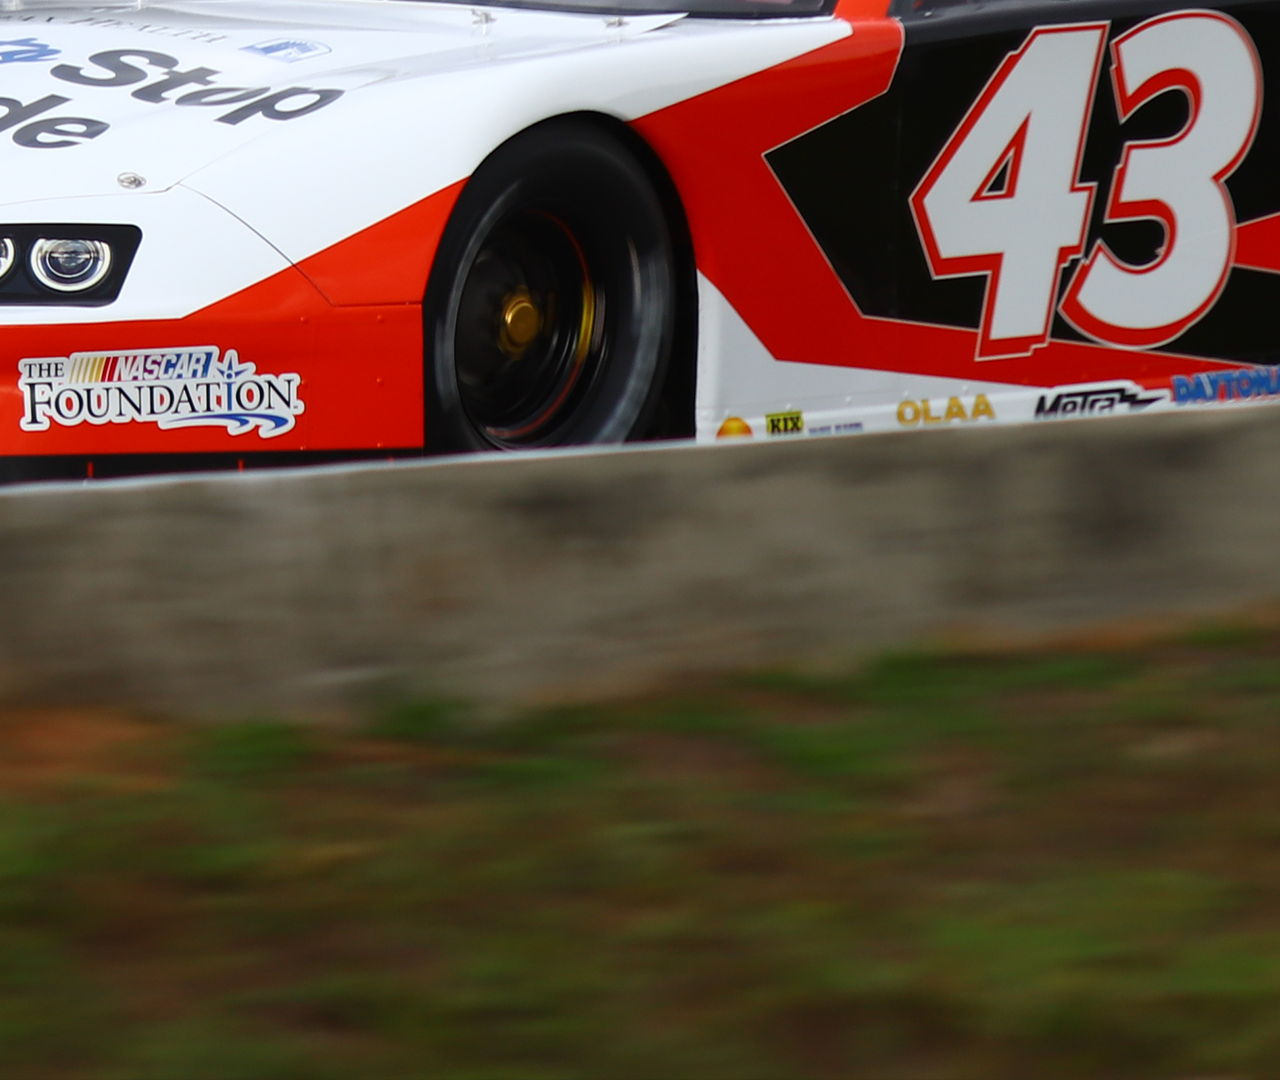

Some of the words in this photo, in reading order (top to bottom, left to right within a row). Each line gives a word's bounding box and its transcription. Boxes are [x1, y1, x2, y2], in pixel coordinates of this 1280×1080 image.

[50, 48, 345, 125] Stop
[910, 9, 1264, 361] 43
[24, 362, 65, 379] THE
[114, 352, 204, 381] NASCAR
[23, 377, 295, 425] FOUNDATION
[896, 392, 995, 427] OLAA
[770, 415, 803, 434] KIX
